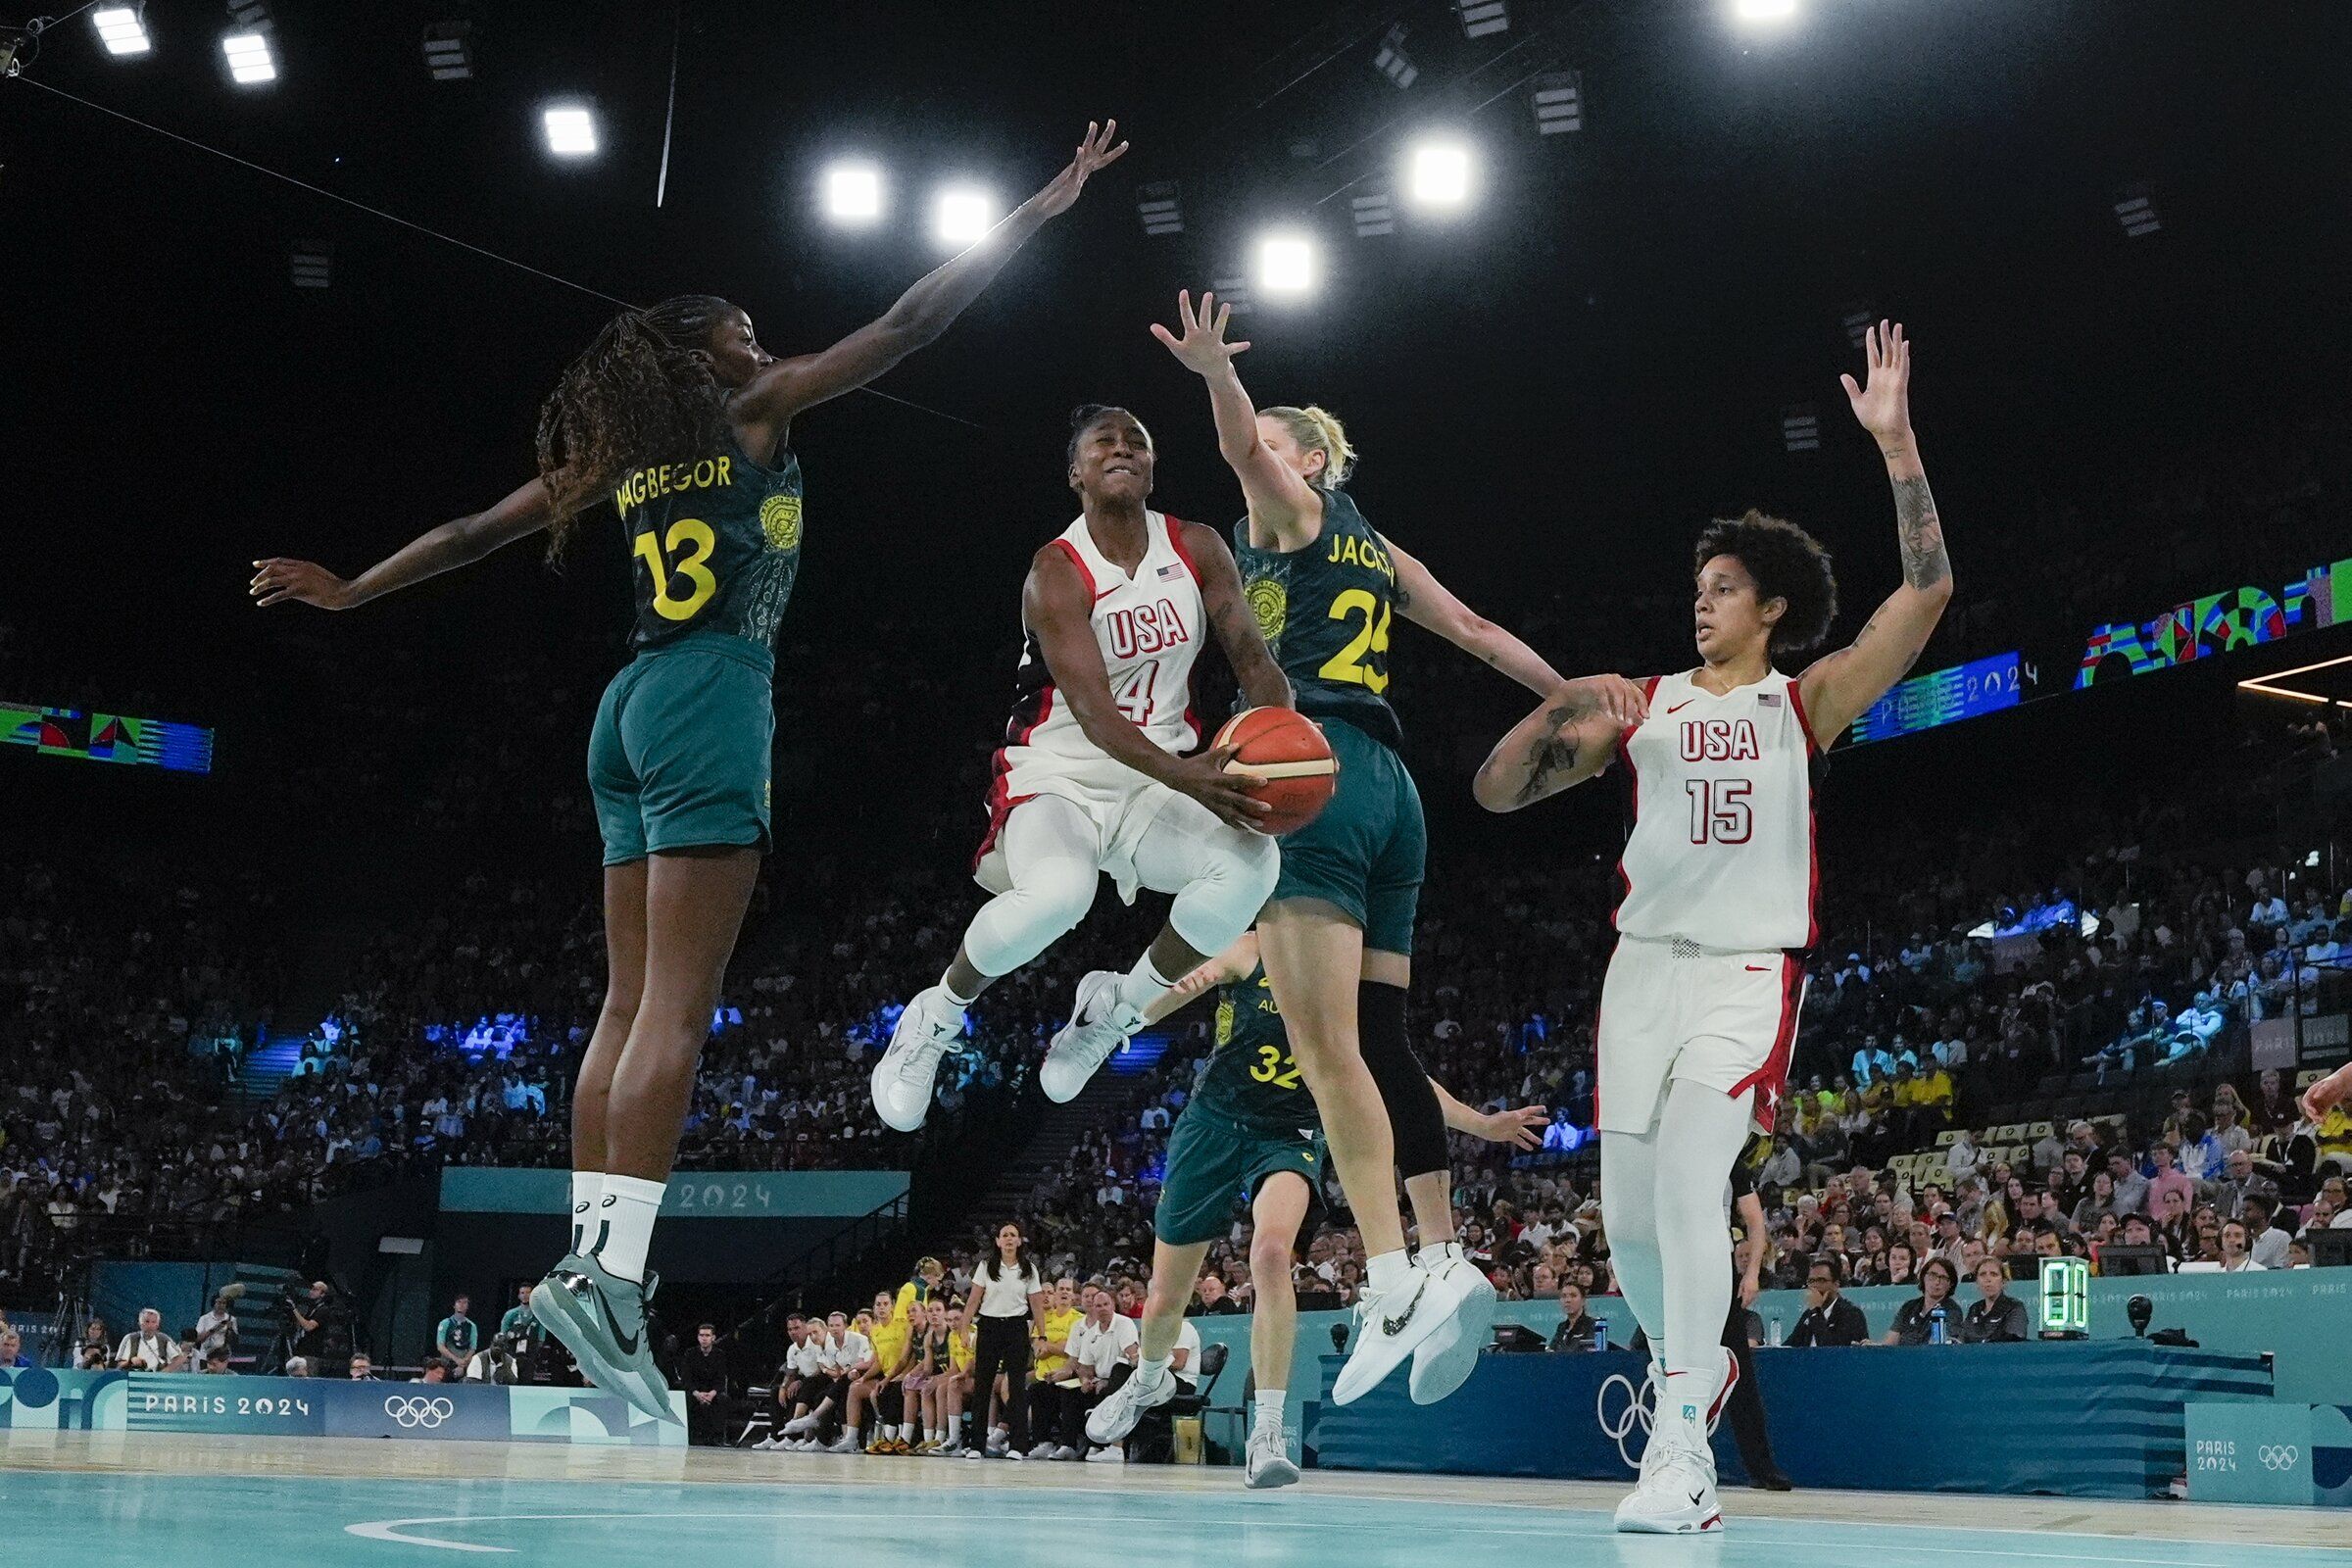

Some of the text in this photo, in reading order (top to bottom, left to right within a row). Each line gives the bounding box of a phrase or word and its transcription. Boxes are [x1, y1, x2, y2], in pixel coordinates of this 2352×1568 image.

[634, 518, 716, 620] 13
[1107, 599, 1189, 659] USA
[1114, 660, 1159, 726] 4
[1967, 662, 2038, 702] 2024
[1681, 719, 1760, 761] USA
[1686, 779, 1752, 845] 15
[1250, 1045, 1301, 1090] 32
[680, 1184, 771, 1208] 2024
[10, 1323, 37, 1334] ARIS
[146, 1395, 309, 1416] PARIS 2024
[2196, 1440, 2235, 1455] PARIS
[2197, 1456, 2236, 1471] 2024
